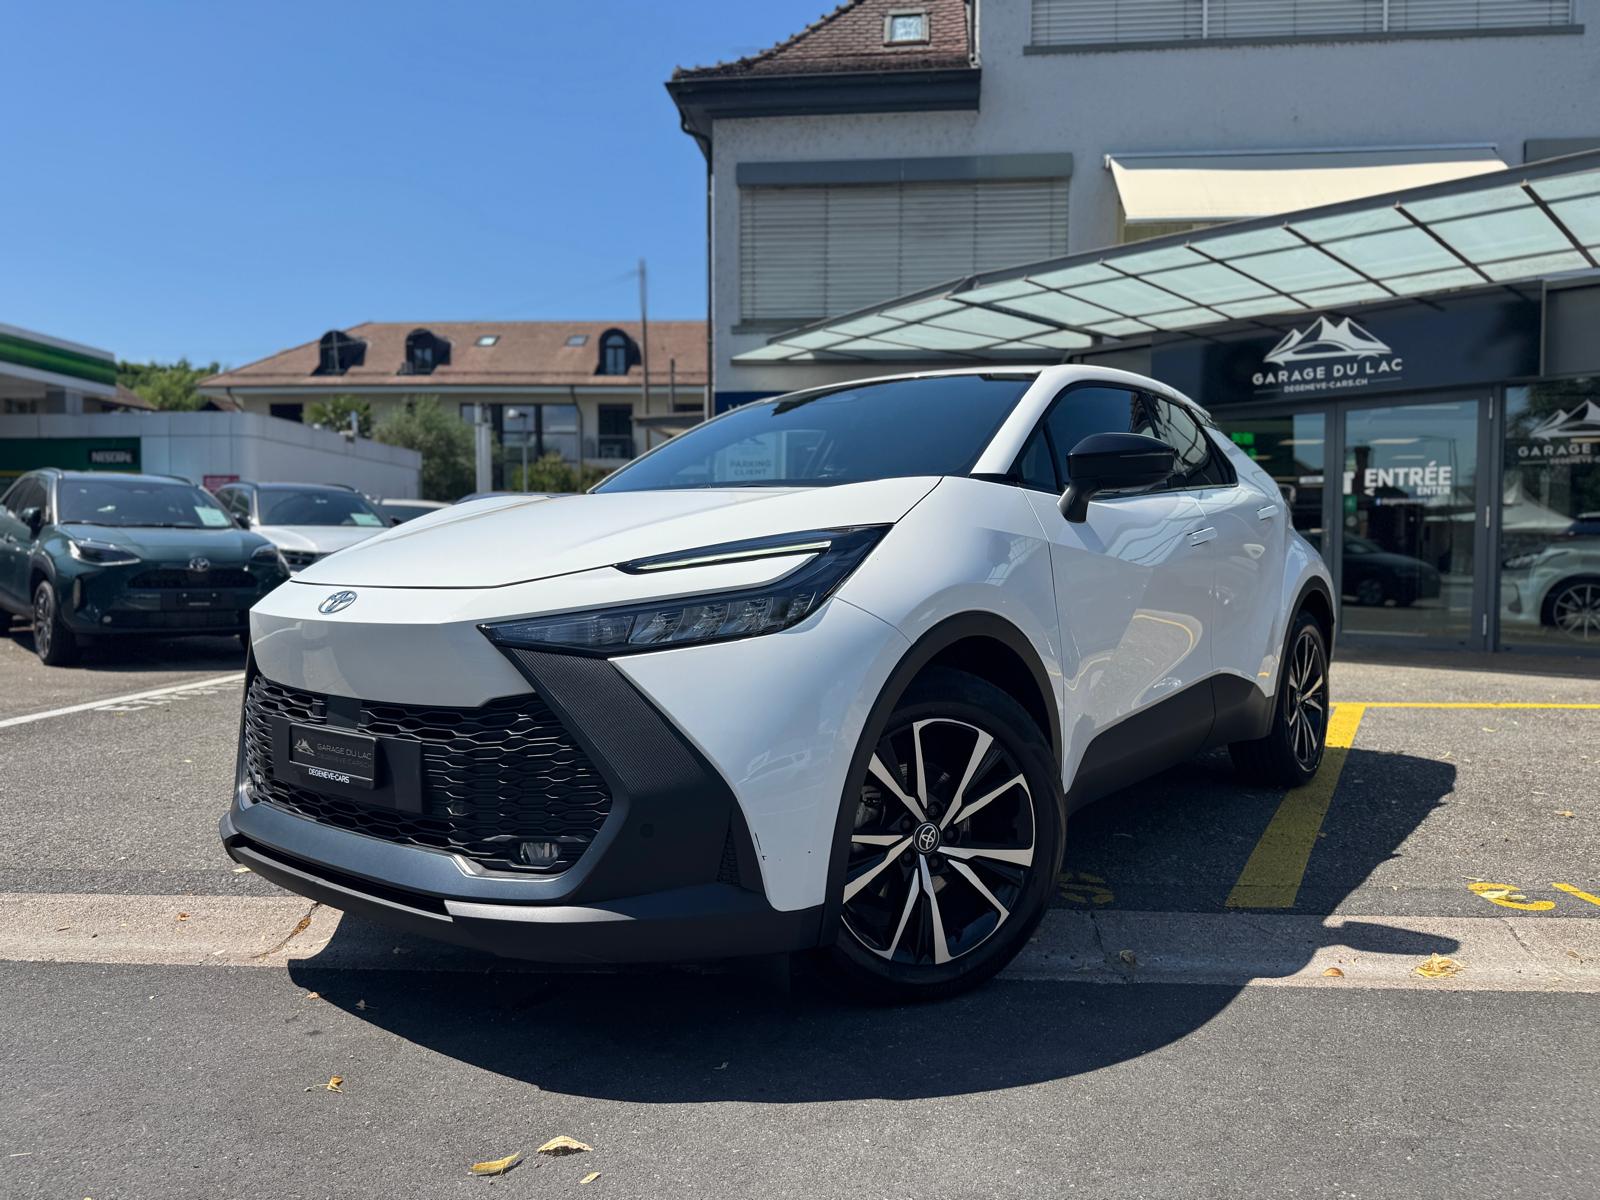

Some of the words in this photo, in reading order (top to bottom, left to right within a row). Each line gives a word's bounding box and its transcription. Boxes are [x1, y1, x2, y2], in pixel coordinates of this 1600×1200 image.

[1252, 366, 1326, 386] GARAGE
[1333, 363, 1358, 378] DU
[1365, 358, 1403, 374] LAC
[1283, 378, 1368, 393] DEGENEVE-CARS.CH
[1517, 443, 1591, 457] GARAGE
[1364, 460, 1452, 488] ENTRÉE
[1416, 485, 1451, 496] ENTER
[317, 744, 344, 754] GARAGE
[346, 748, 356, 757] DU
[358, 752, 372, 760] LAC
[308, 768, 350, 783] DEGENEVE-CARS
